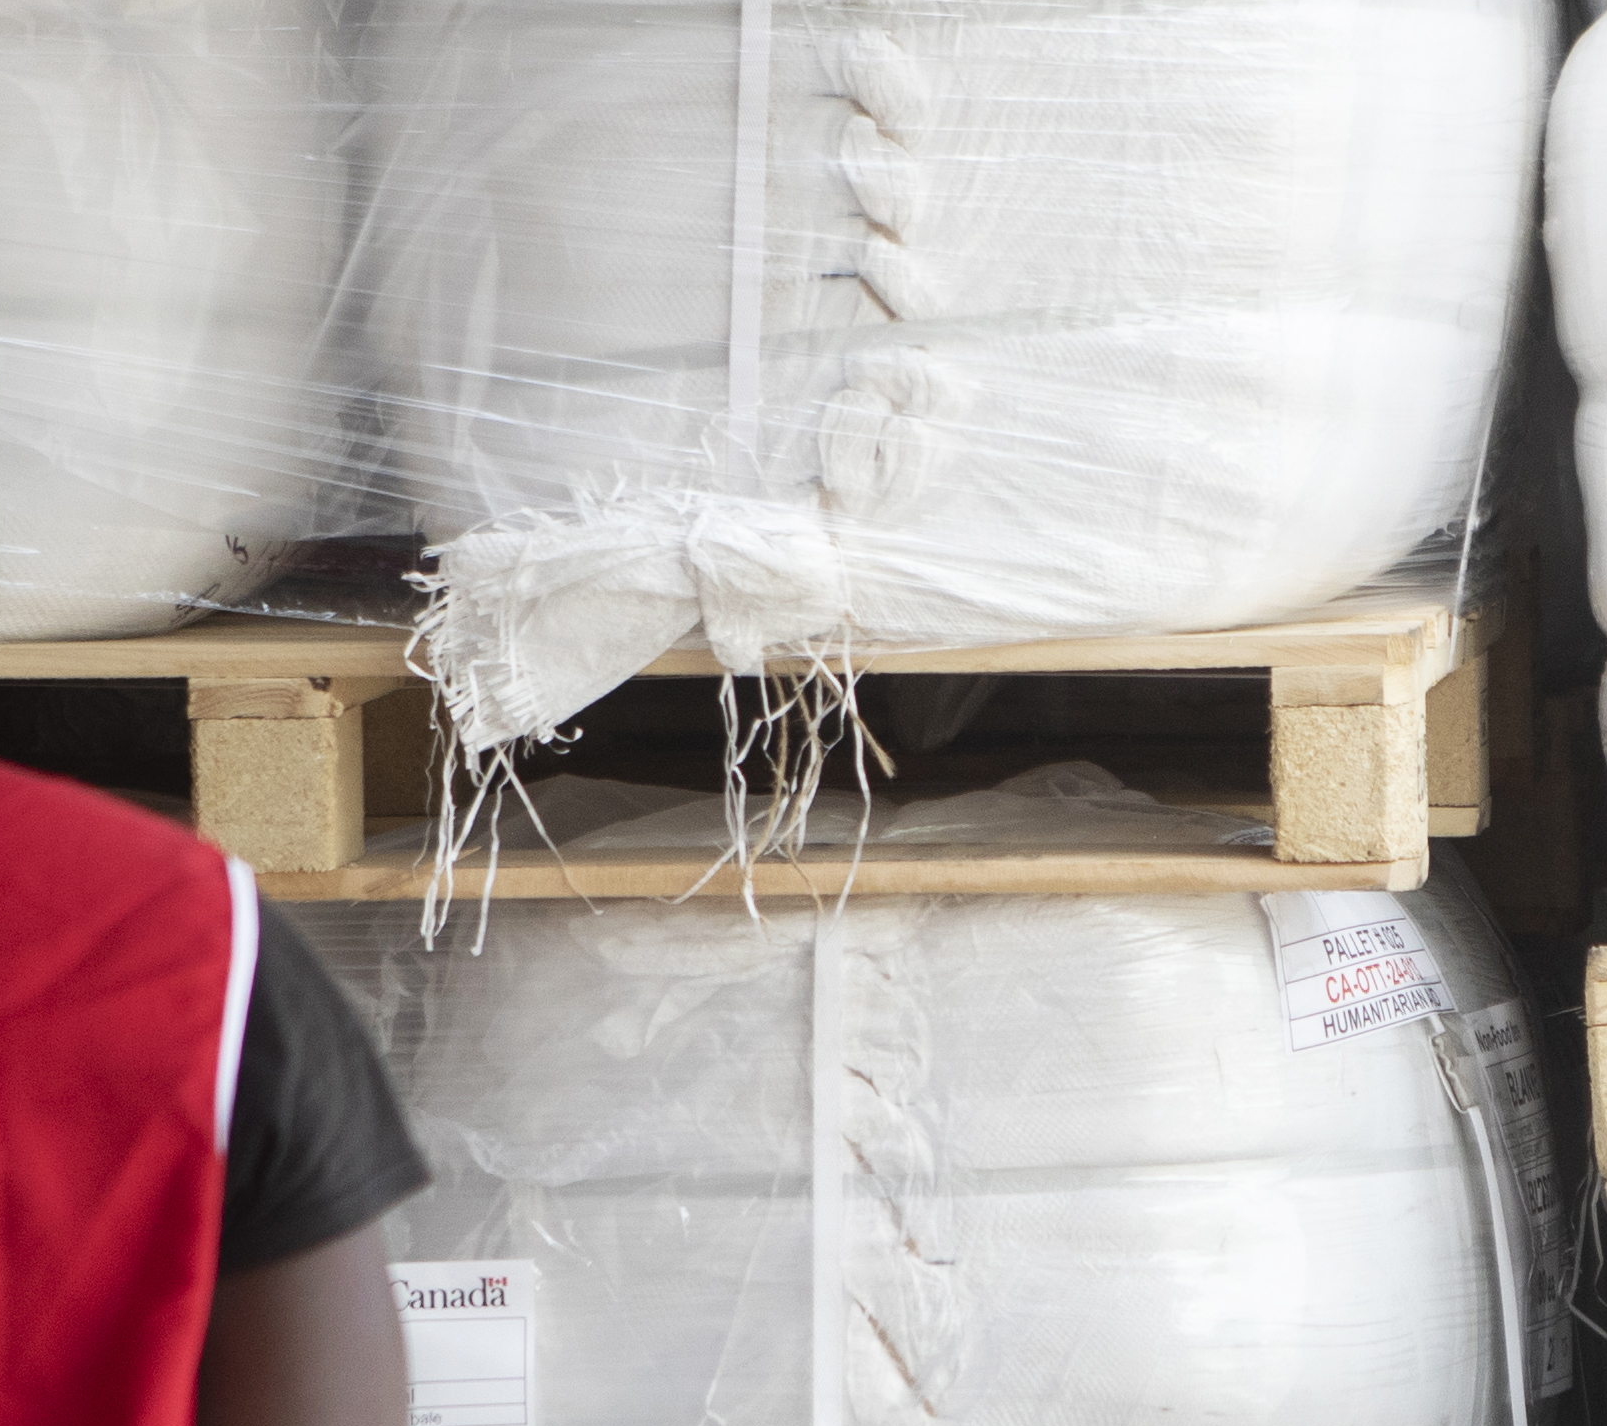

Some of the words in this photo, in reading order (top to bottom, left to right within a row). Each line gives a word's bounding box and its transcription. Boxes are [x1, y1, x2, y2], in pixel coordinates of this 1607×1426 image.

[1322, 929, 1377, 966] PALLET
[1381, 925, 1406, 951] 025
[1322, 989, 1428, 1039] HUMANITARIAN
